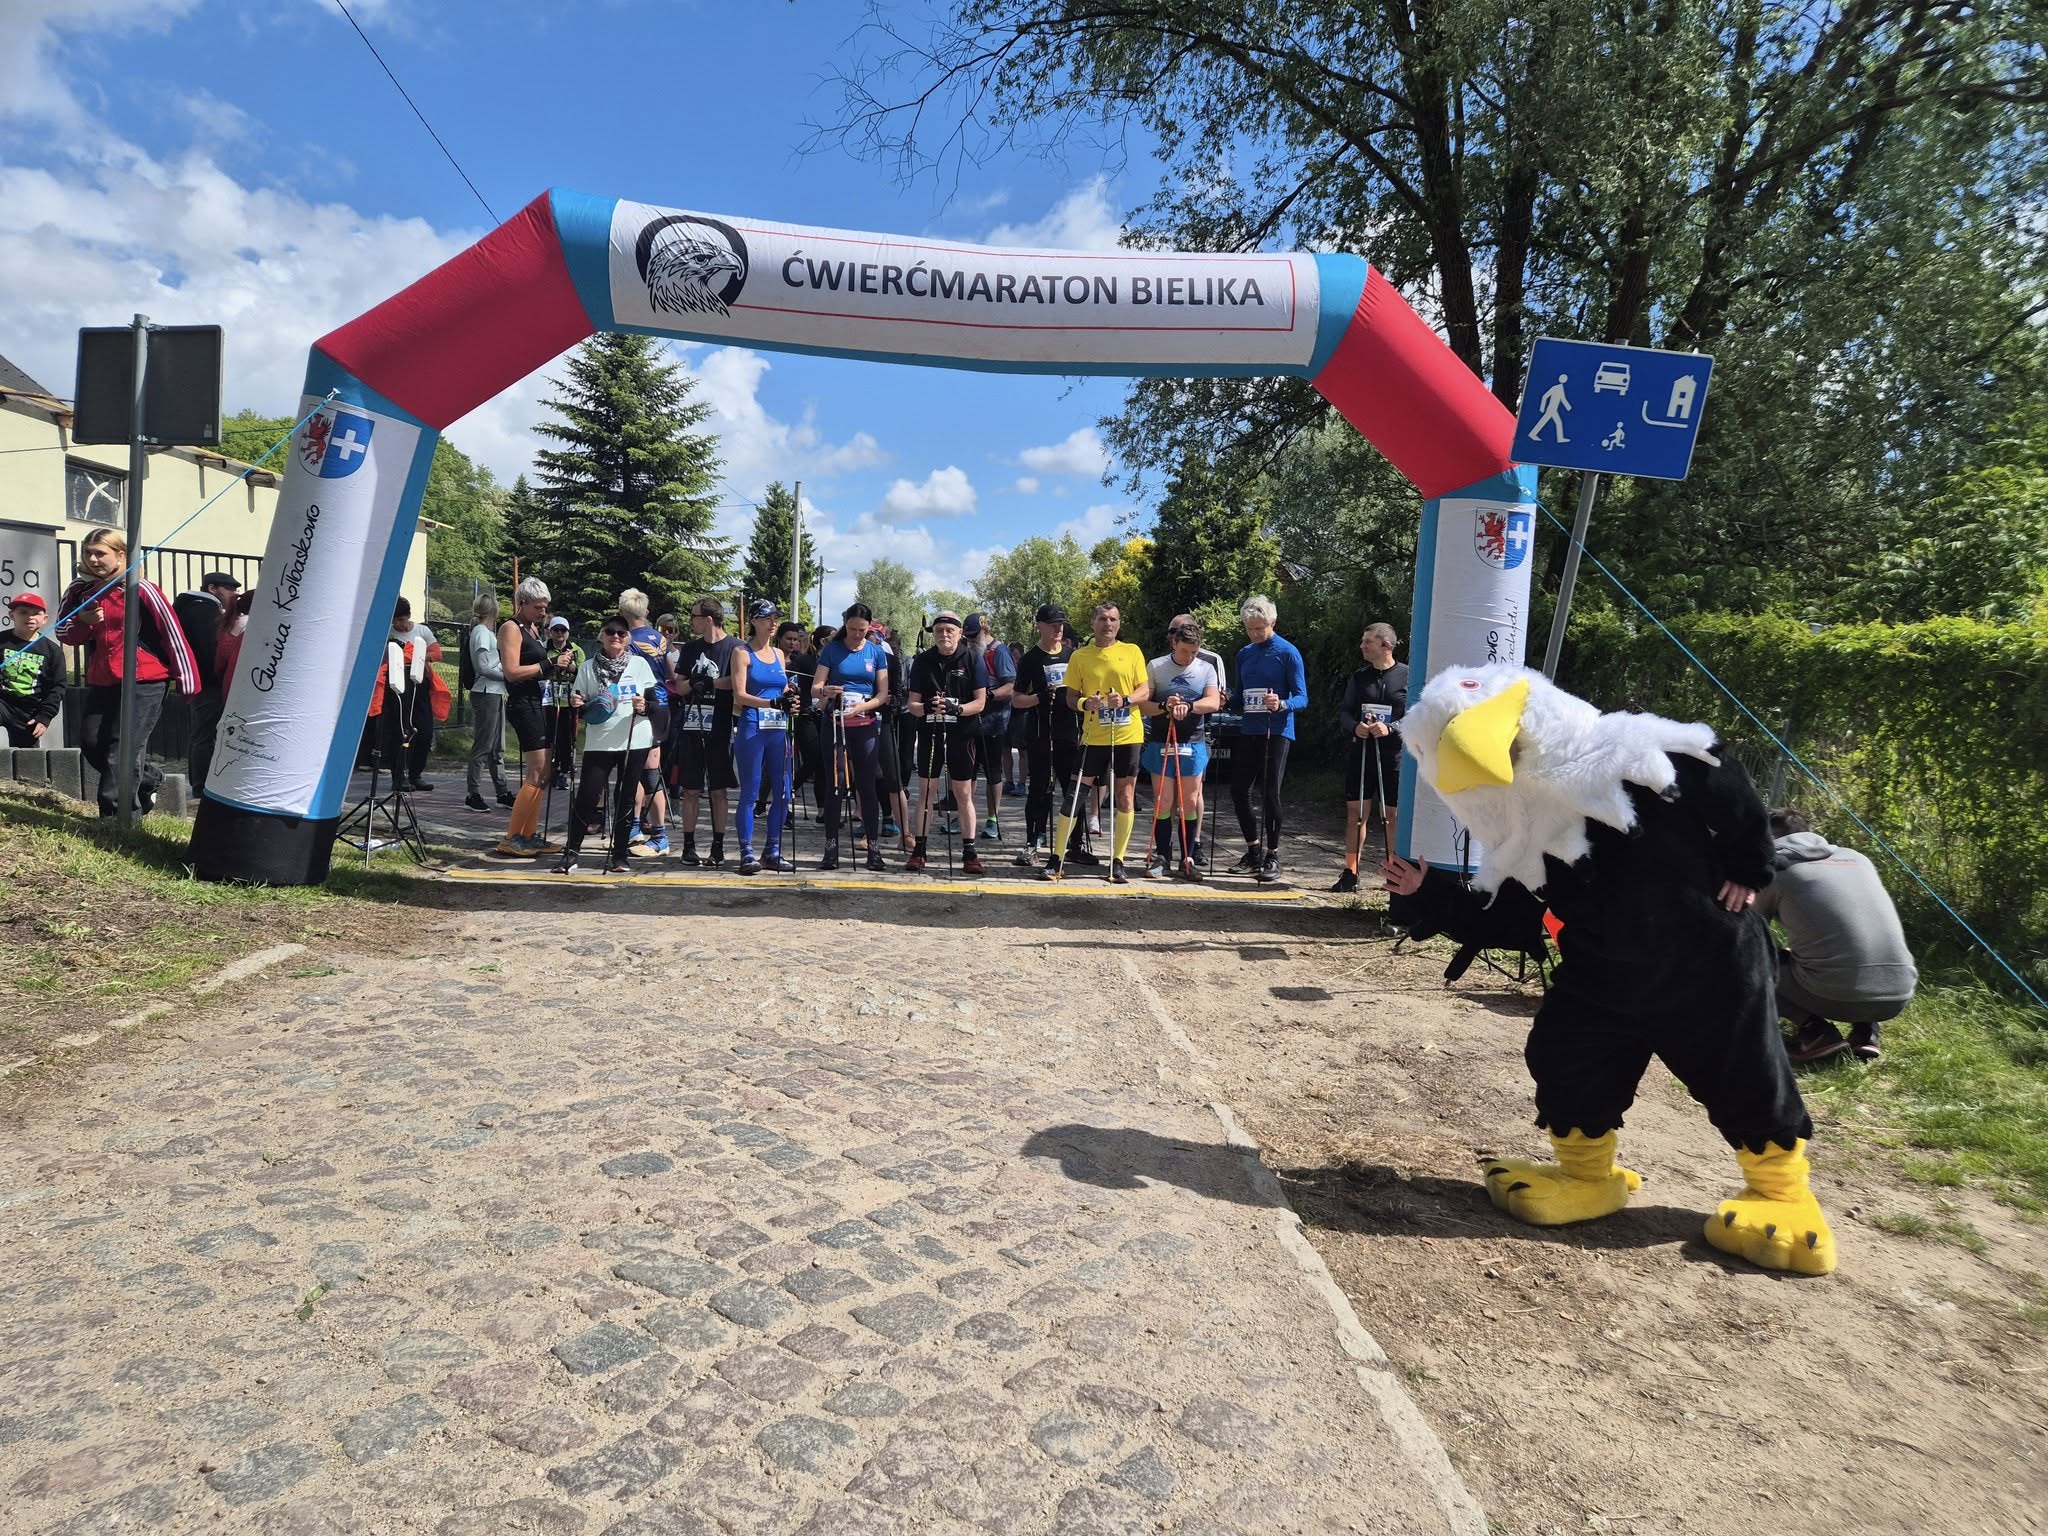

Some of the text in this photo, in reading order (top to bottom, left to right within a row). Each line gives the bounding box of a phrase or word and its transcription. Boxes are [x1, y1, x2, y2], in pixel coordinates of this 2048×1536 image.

[782, 249, 1265, 306] ĆWIERĆMARATON BIELIKA
[251, 623, 291, 692] Gmina
[273, 504, 320, 611] Kołbaskowo
